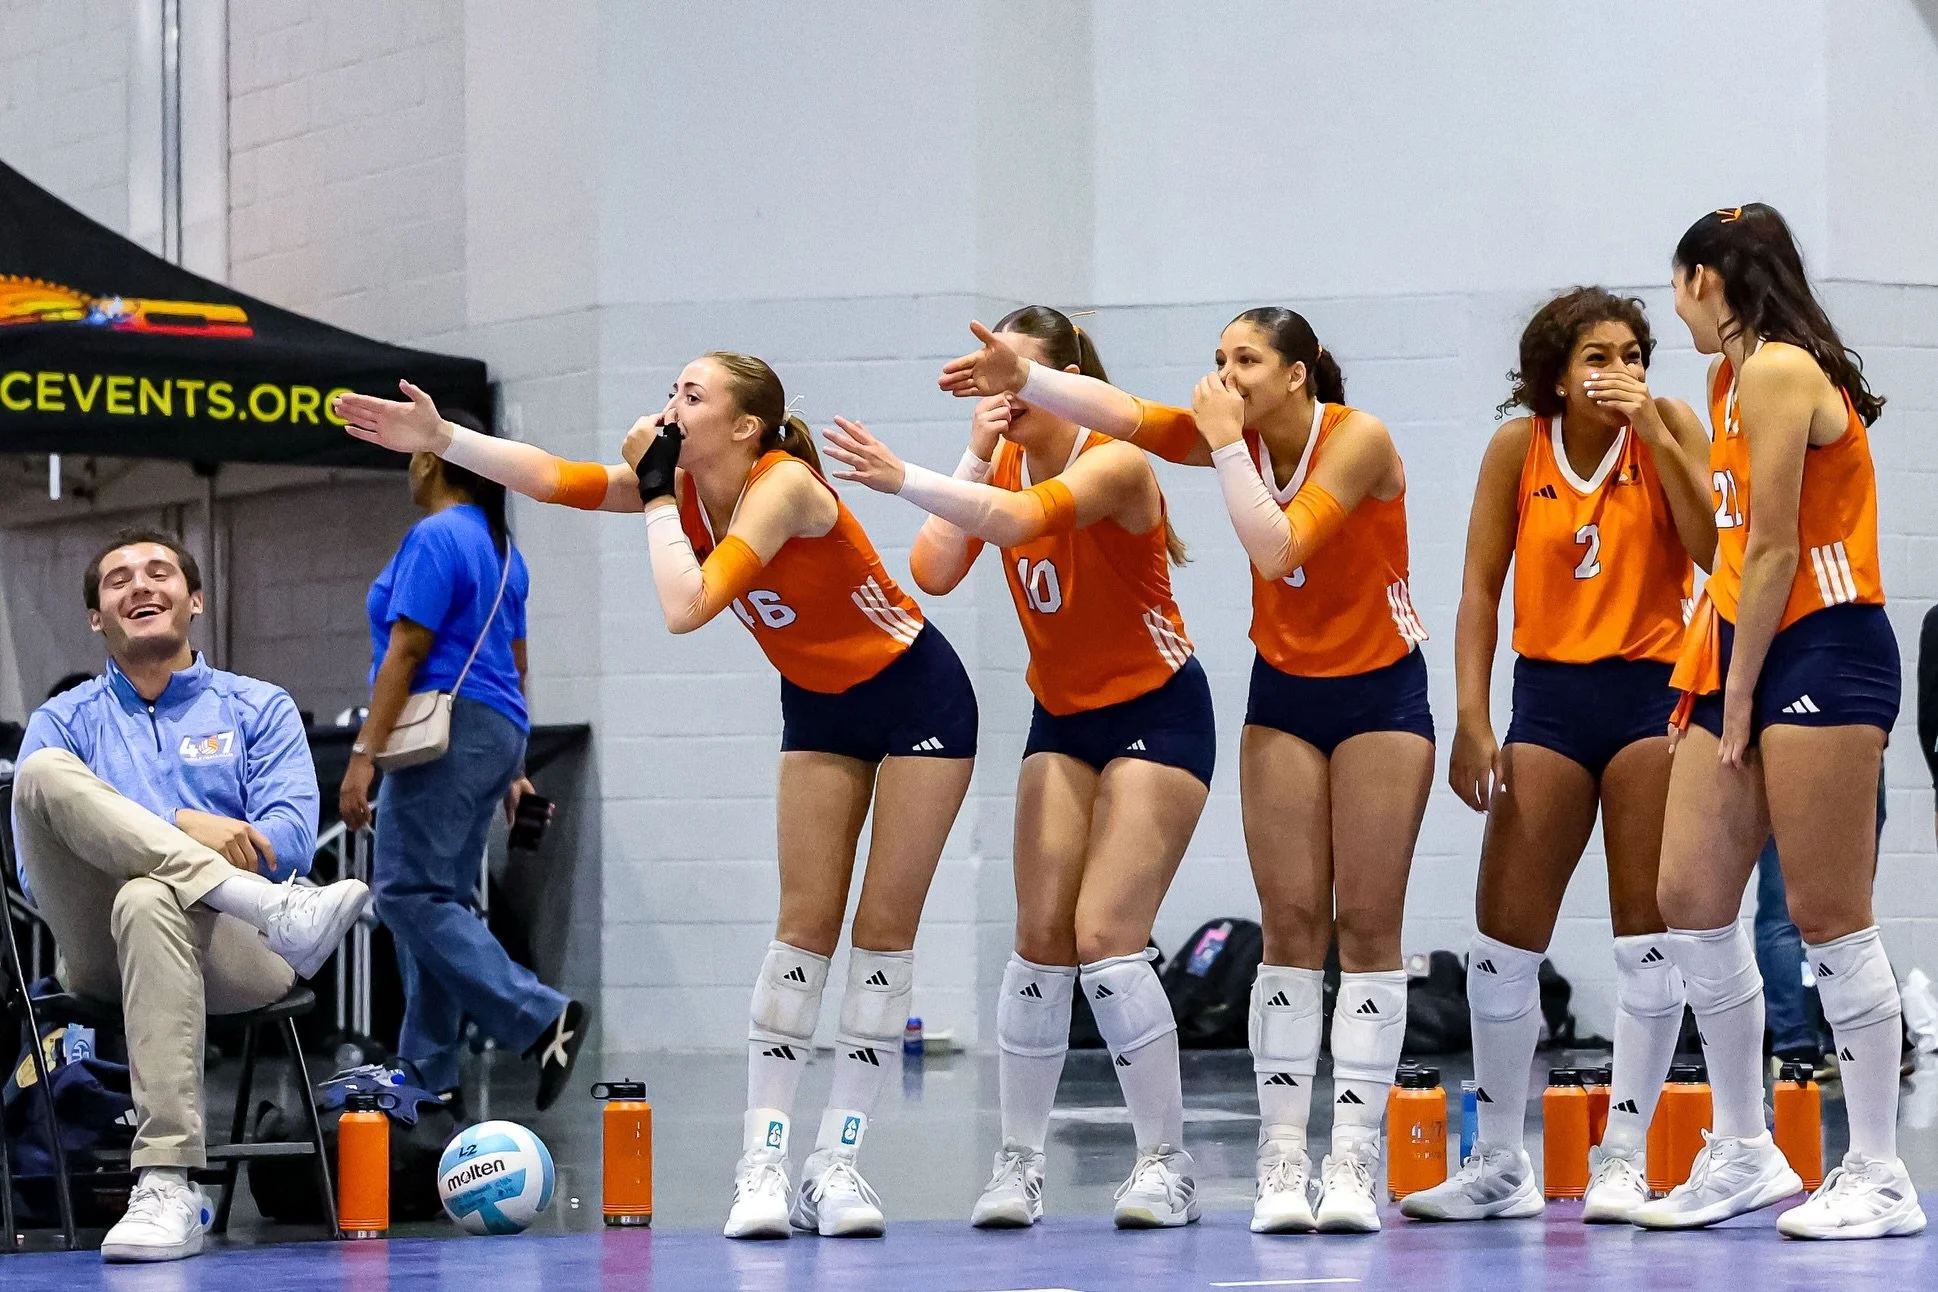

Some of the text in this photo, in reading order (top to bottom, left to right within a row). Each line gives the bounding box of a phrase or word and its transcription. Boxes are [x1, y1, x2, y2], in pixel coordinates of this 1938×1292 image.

[1574, 524, 1600, 579] 2
[1018, 558, 1062, 613] 10
[447, 1159, 506, 1192] molten
